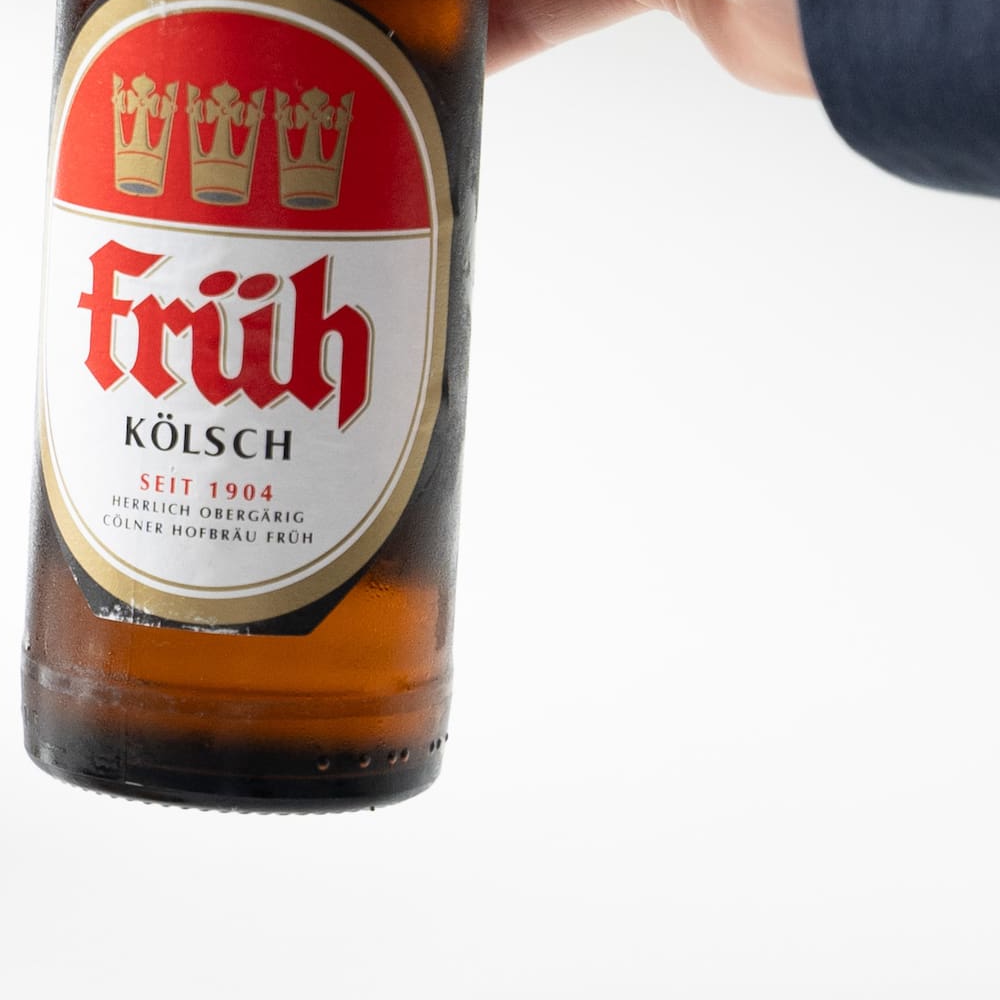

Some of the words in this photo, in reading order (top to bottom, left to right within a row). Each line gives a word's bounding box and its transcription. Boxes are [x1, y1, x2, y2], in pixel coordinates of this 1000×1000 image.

[124, 412, 292, 461] KÖLSCH
[140, 473, 193, 496] SEIT
[210, 481, 273, 502] 1904
[112, 495, 191, 516] HERRLICH
[200, 506, 304, 524] OBERGÄRIG
[103, 514, 163, 534] CÖLNER
[172, 524, 257, 543] HOFBRÄU
[266, 530, 313, 545] FRÜH
